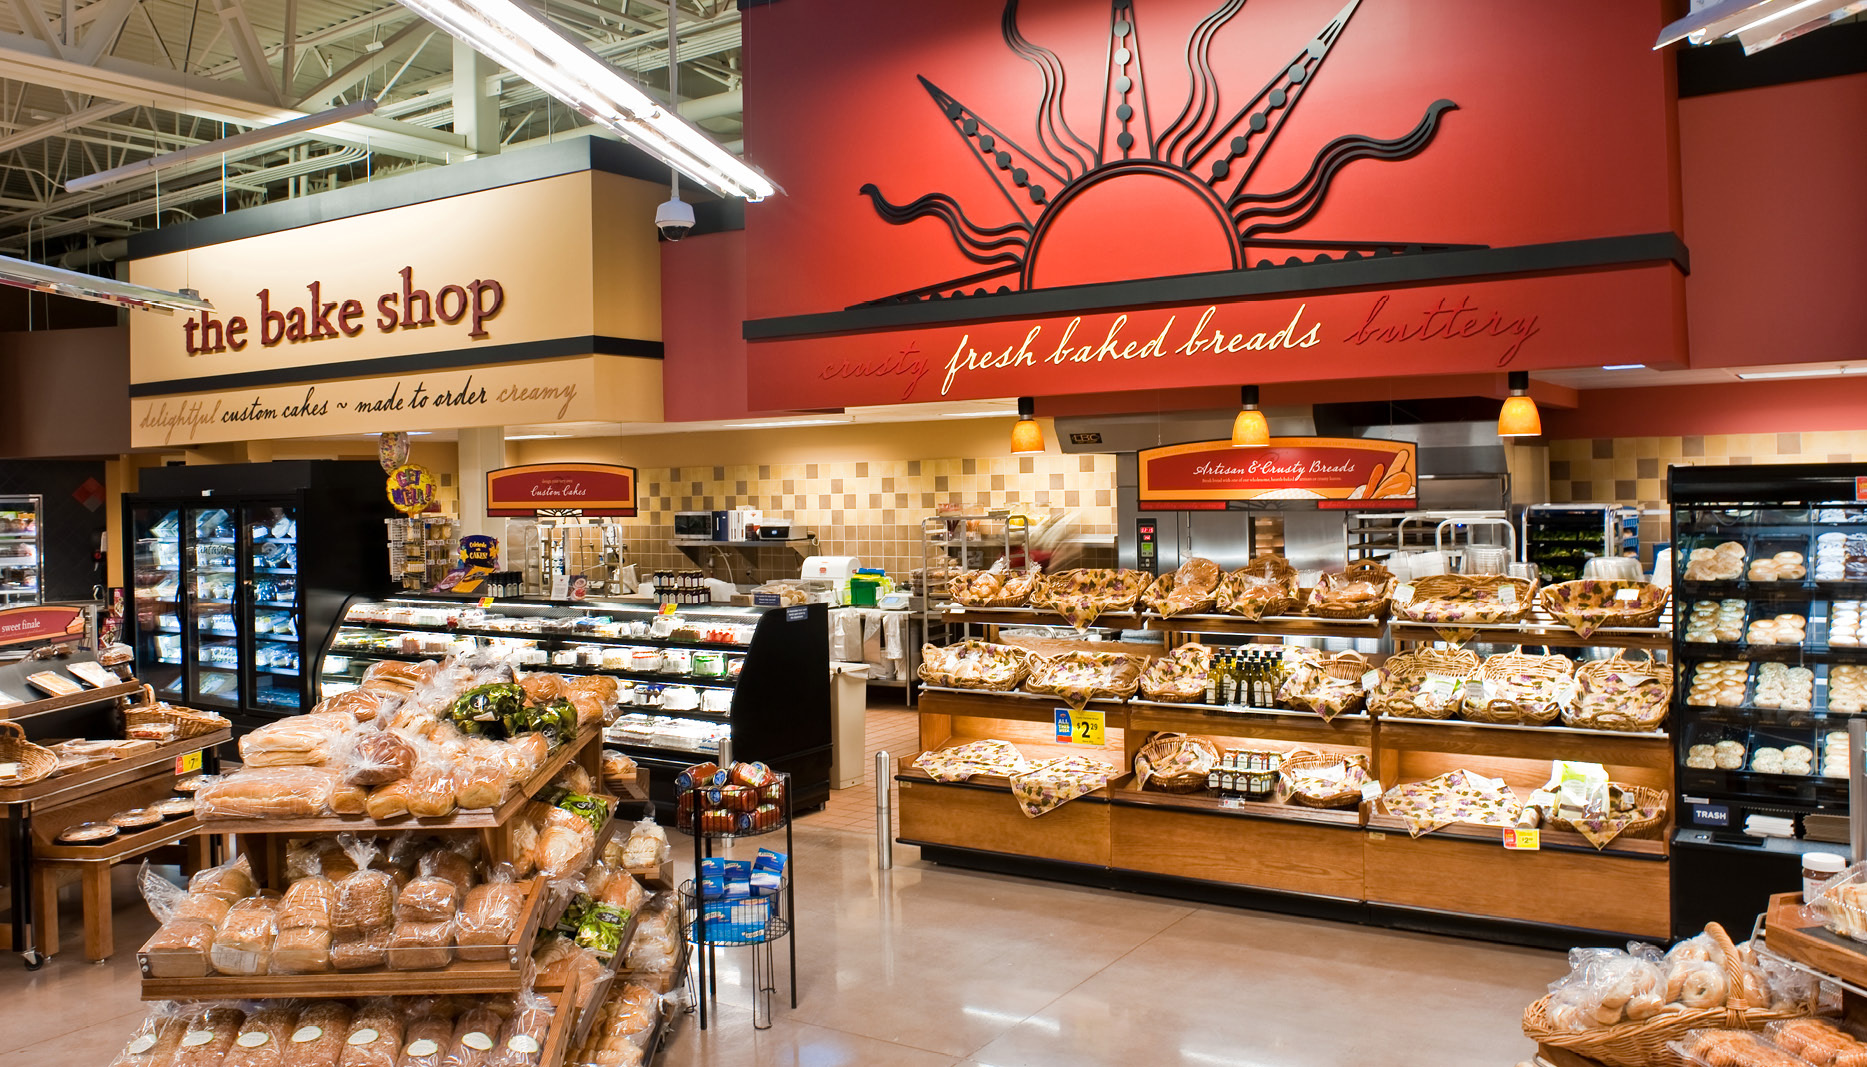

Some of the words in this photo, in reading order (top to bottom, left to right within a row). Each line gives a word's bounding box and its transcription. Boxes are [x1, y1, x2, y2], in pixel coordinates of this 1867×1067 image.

[183, 298, 248, 355] the
[256, 281, 363, 346] bake
[377, 266, 504, 338] shop
[818, 340, 929, 400] crusty
[941, 326, 1037, 395] fresh
[1045, 314, 1175, 365] baked
[1175, 304, 1321, 356] breads
[1344, 294, 1540, 367] buttery
[139, 399, 222, 445] delightful
[221, 396, 278, 423] custom
[281, 386, 328, 418] cakes
[355, 381, 404, 413] made
[407, 381, 429, 409] to
[433, 375, 487, 407] order
[496, 383, 577, 420] creamy
[396, 469, 422, 487] GET
[1193, 461, 1245, 475] Artisan
[1248, 461, 1261, 474] &
[1261, 460, 1305, 481] Crusty
[1309, 459, 1354, 473] Breads
[531, 485, 560, 496] Custom
[562, 483, 587, 496] Cakes
[1, 621, 21, 632] sweet
[22, 618, 40, 630] finale
[1696, 810, 1727, 820] TRASH
